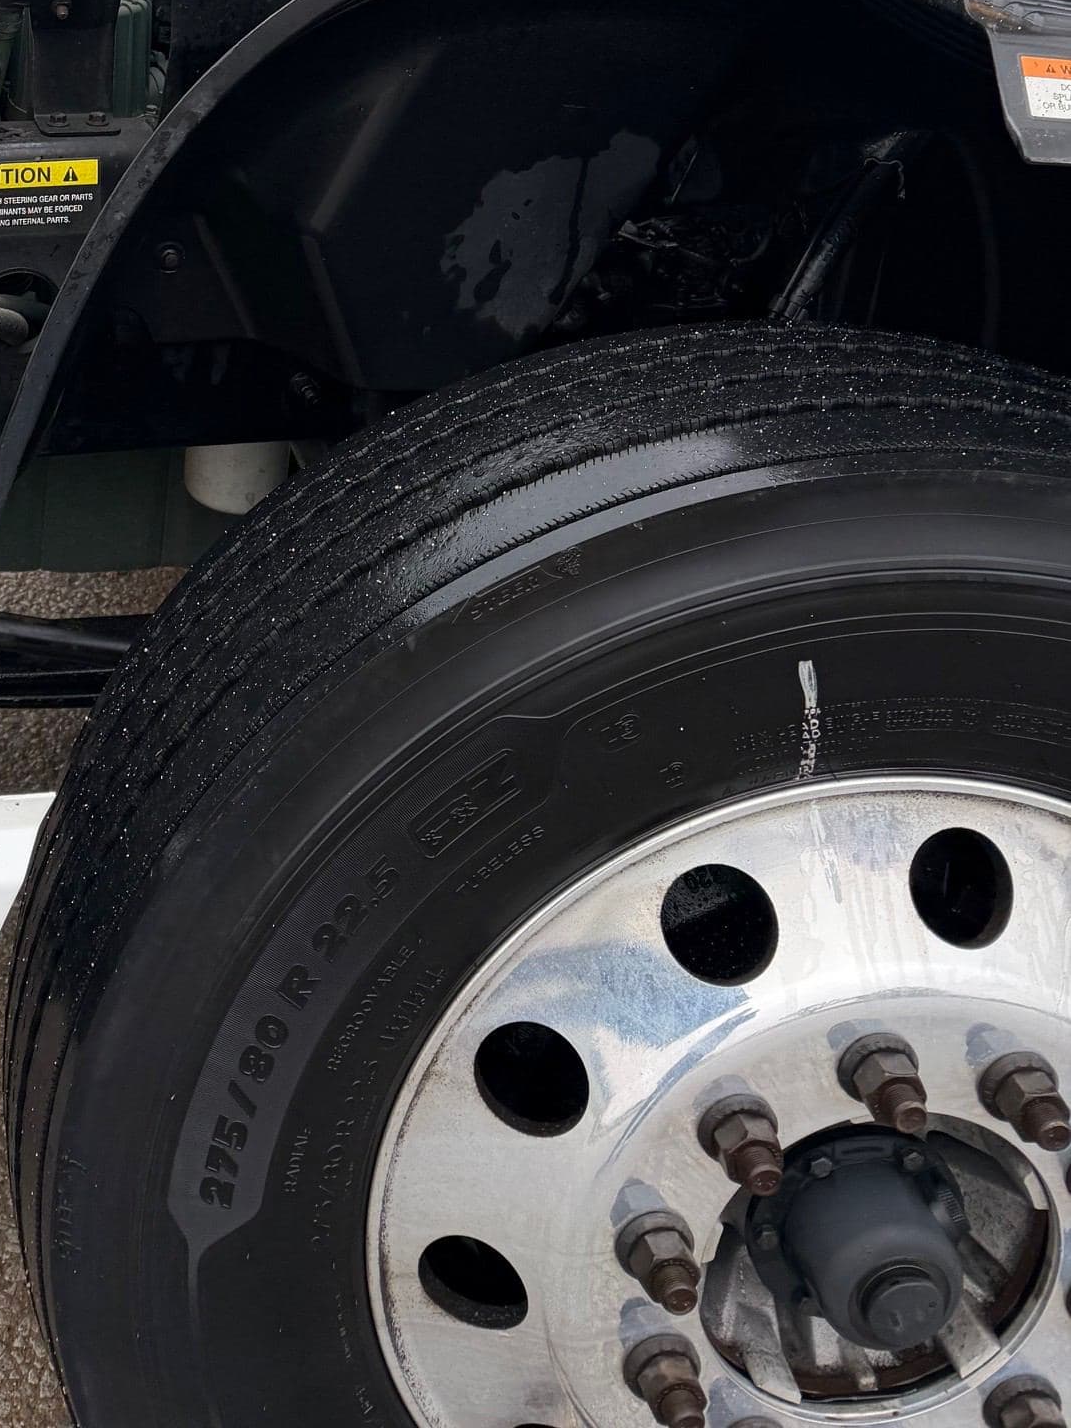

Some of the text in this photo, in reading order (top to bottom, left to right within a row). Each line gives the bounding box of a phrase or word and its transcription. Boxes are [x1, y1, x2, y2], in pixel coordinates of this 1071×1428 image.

[1052, 92, 1071, 101] SPL
[1042, 101, 1056, 110] OR
[3, 195, 38, 205] STEERING
[39, 194, 58, 203] GEAR
[59, 193, 70, 202] OR
[71, 192, 93, 202] PARTS
[27, 206, 42, 215] MAY
[43, 205, 53, 214] BE
[54, 204, 83, 214] FORCED
[11, 217, 45, 226] INTERNAL
[46, 215, 71, 225] PARTS.
[455, 825, 545, 893] TUBELESS
[199, 854, 401, 1210] 275/80 R 22.5
